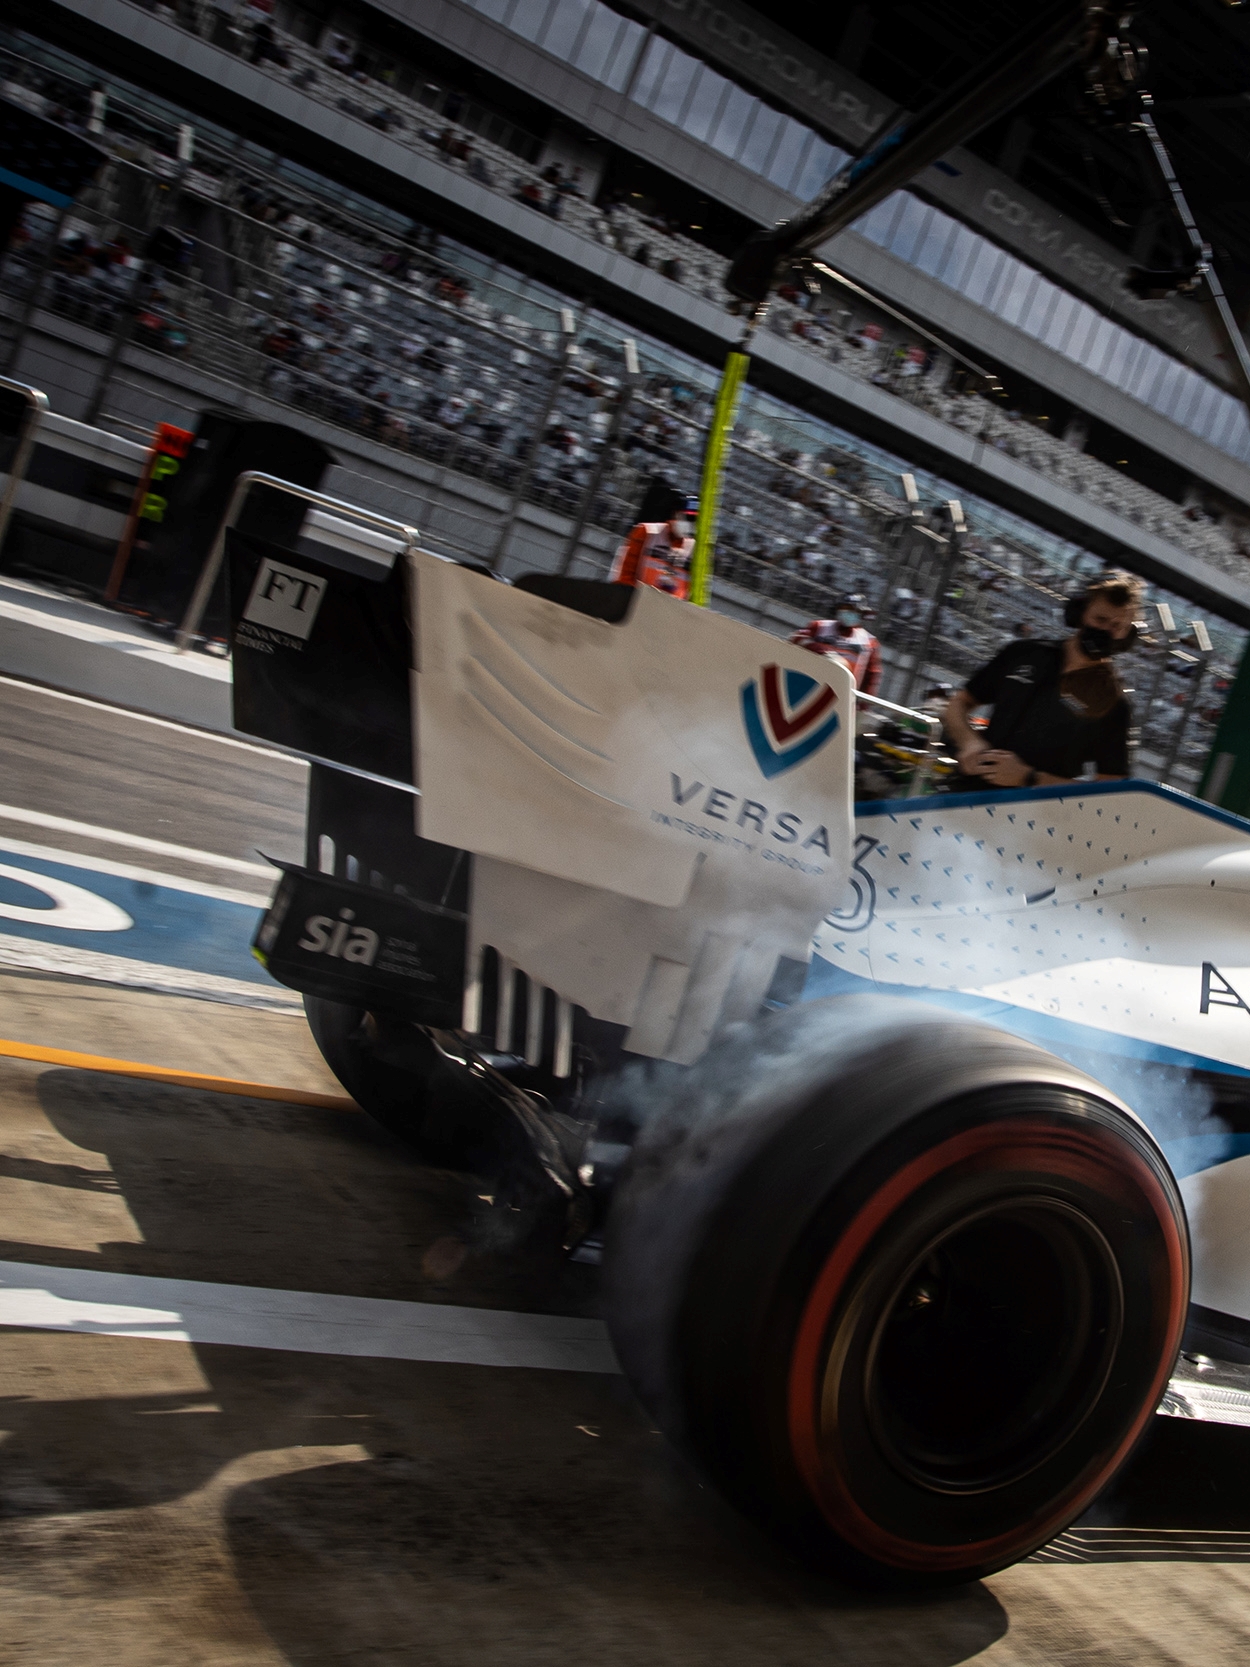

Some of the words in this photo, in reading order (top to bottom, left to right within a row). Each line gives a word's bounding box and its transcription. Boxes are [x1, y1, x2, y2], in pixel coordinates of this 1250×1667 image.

[258, 567, 320, 614] FT
[649, 809, 756, 854] INTEGRITY
[761, 847, 825, 877] GROUP
[669, 771, 832, 857] VERSA
[296, 907, 381, 967] sia
